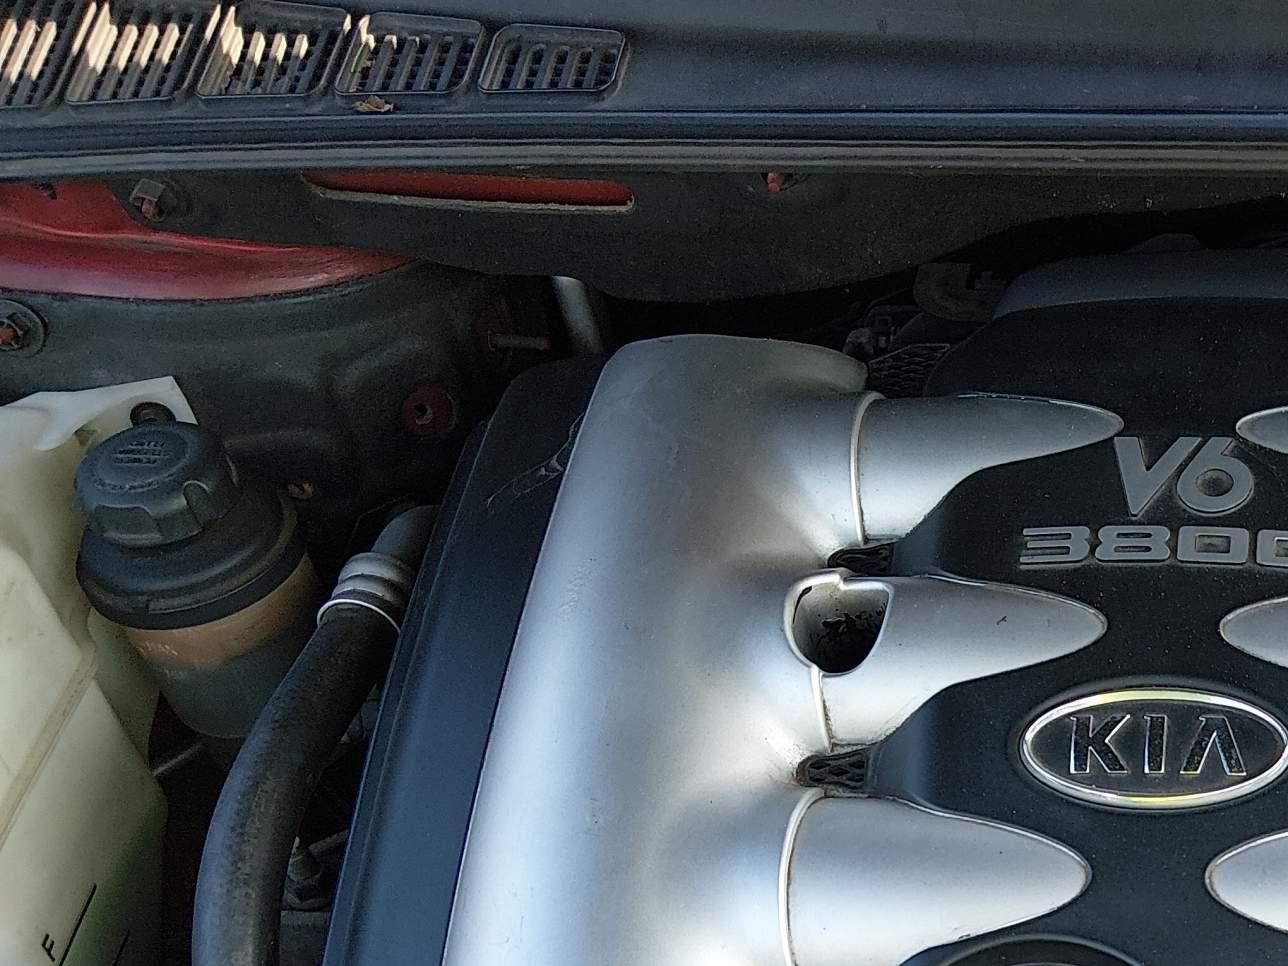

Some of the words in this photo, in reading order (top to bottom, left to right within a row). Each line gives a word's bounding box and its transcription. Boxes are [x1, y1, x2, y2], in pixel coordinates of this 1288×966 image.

[1114, 436, 1254, 516] V6
[1069, 714, 1247, 775] KIA
[41, 932, 56, 962] F
